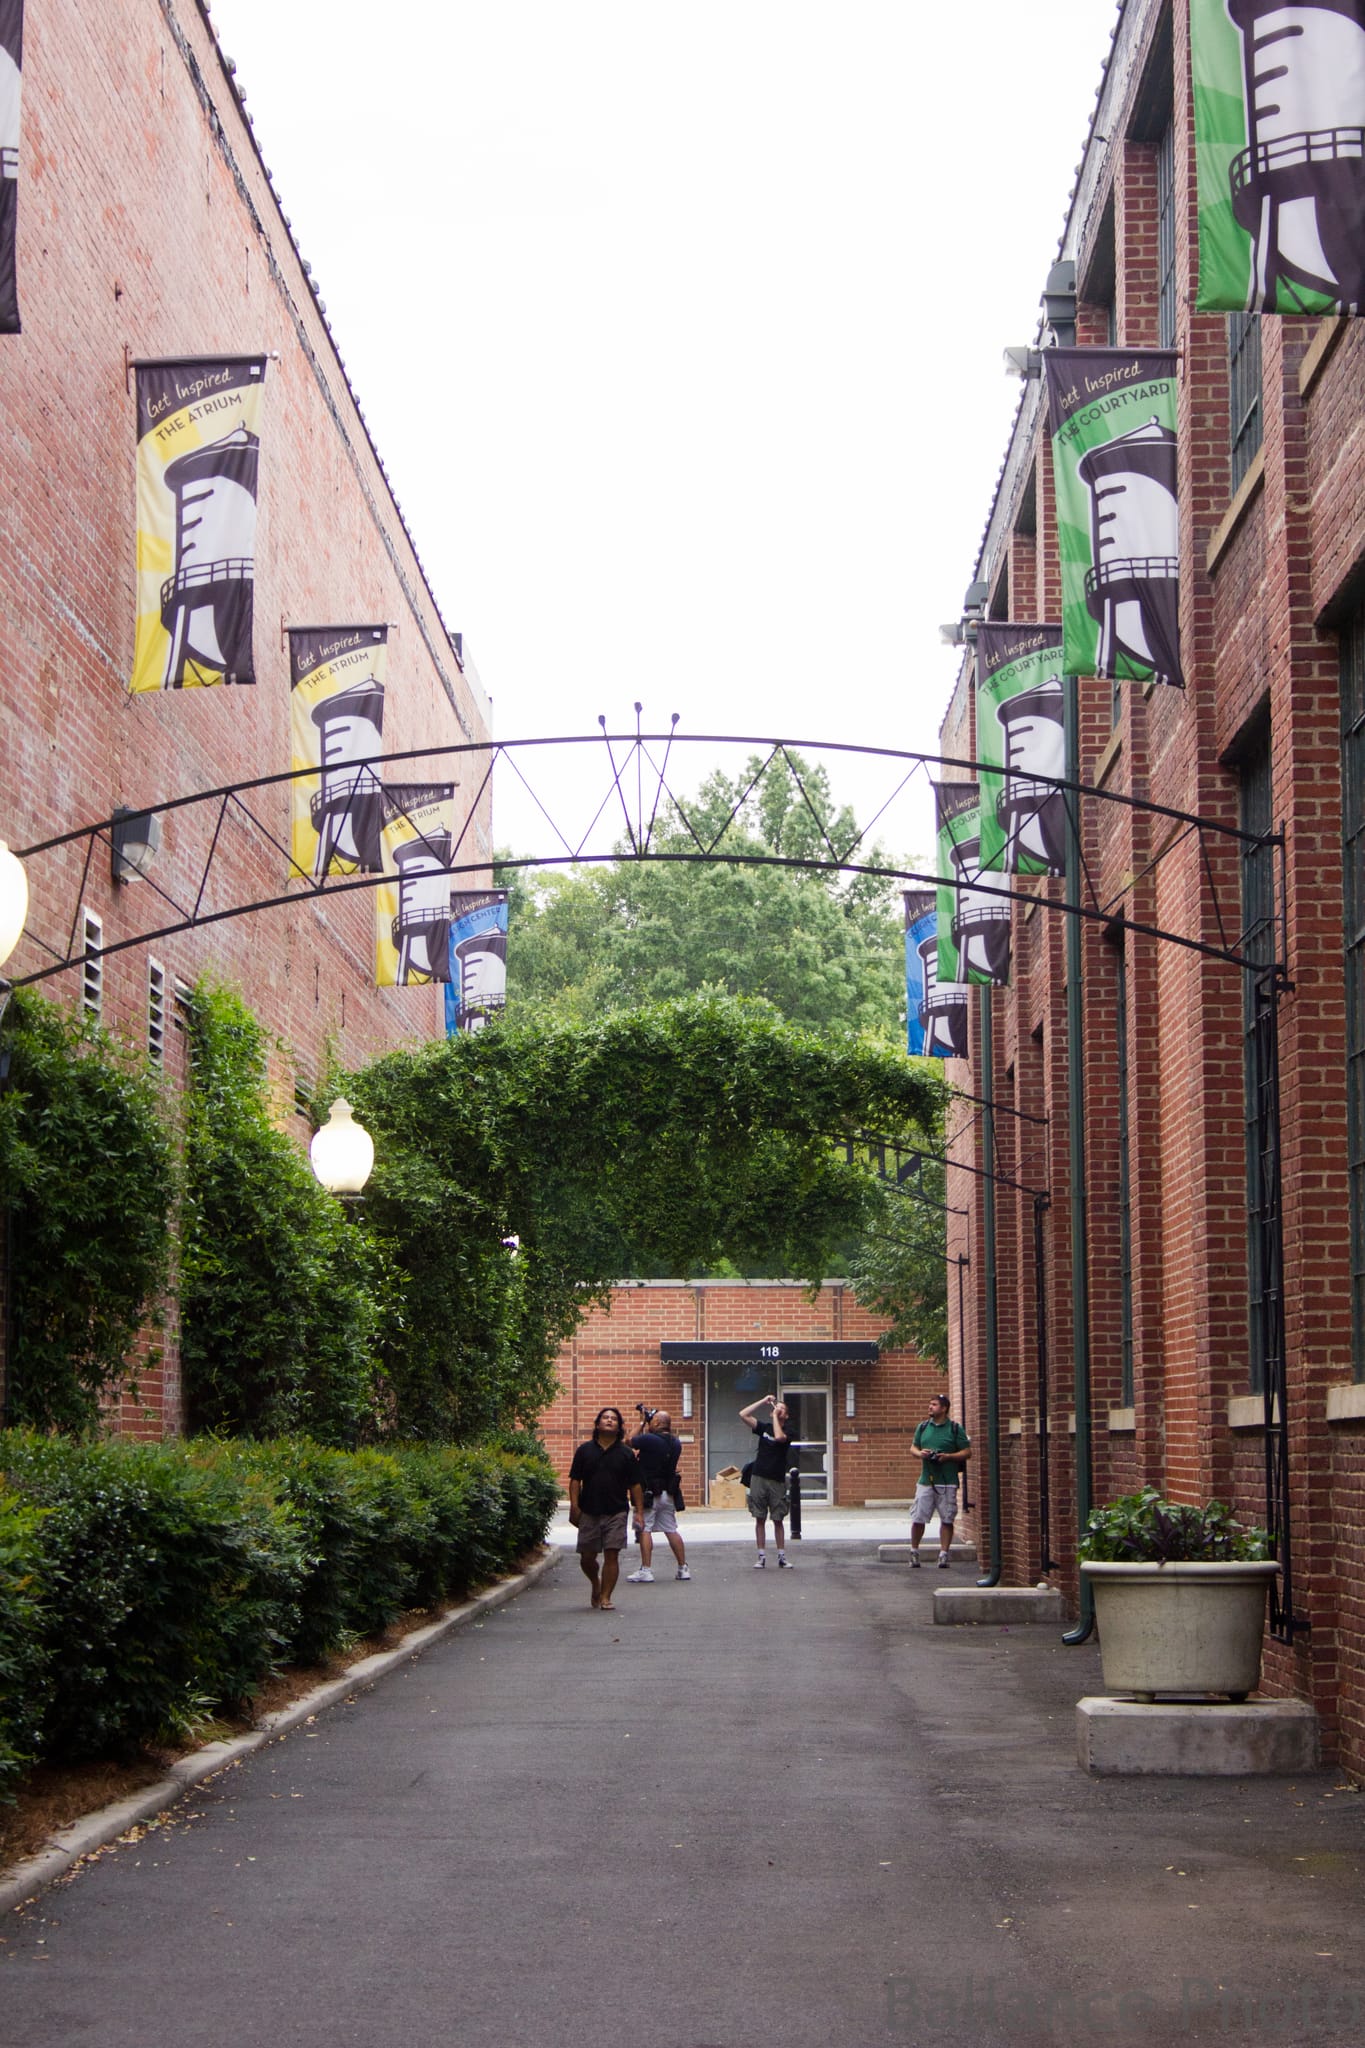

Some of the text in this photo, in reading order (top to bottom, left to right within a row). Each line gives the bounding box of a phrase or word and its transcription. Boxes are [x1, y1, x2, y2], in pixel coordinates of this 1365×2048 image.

[146, 393, 172, 419] Get
[155, 393, 242, 441] THE ATRIUM
[1058, 382, 1170, 446] THE COURTYARD
[296, 651, 317, 671] Get
[304, 652, 369, 689] THE ATRIUM
[760, 1346, 779, 1357] 118
